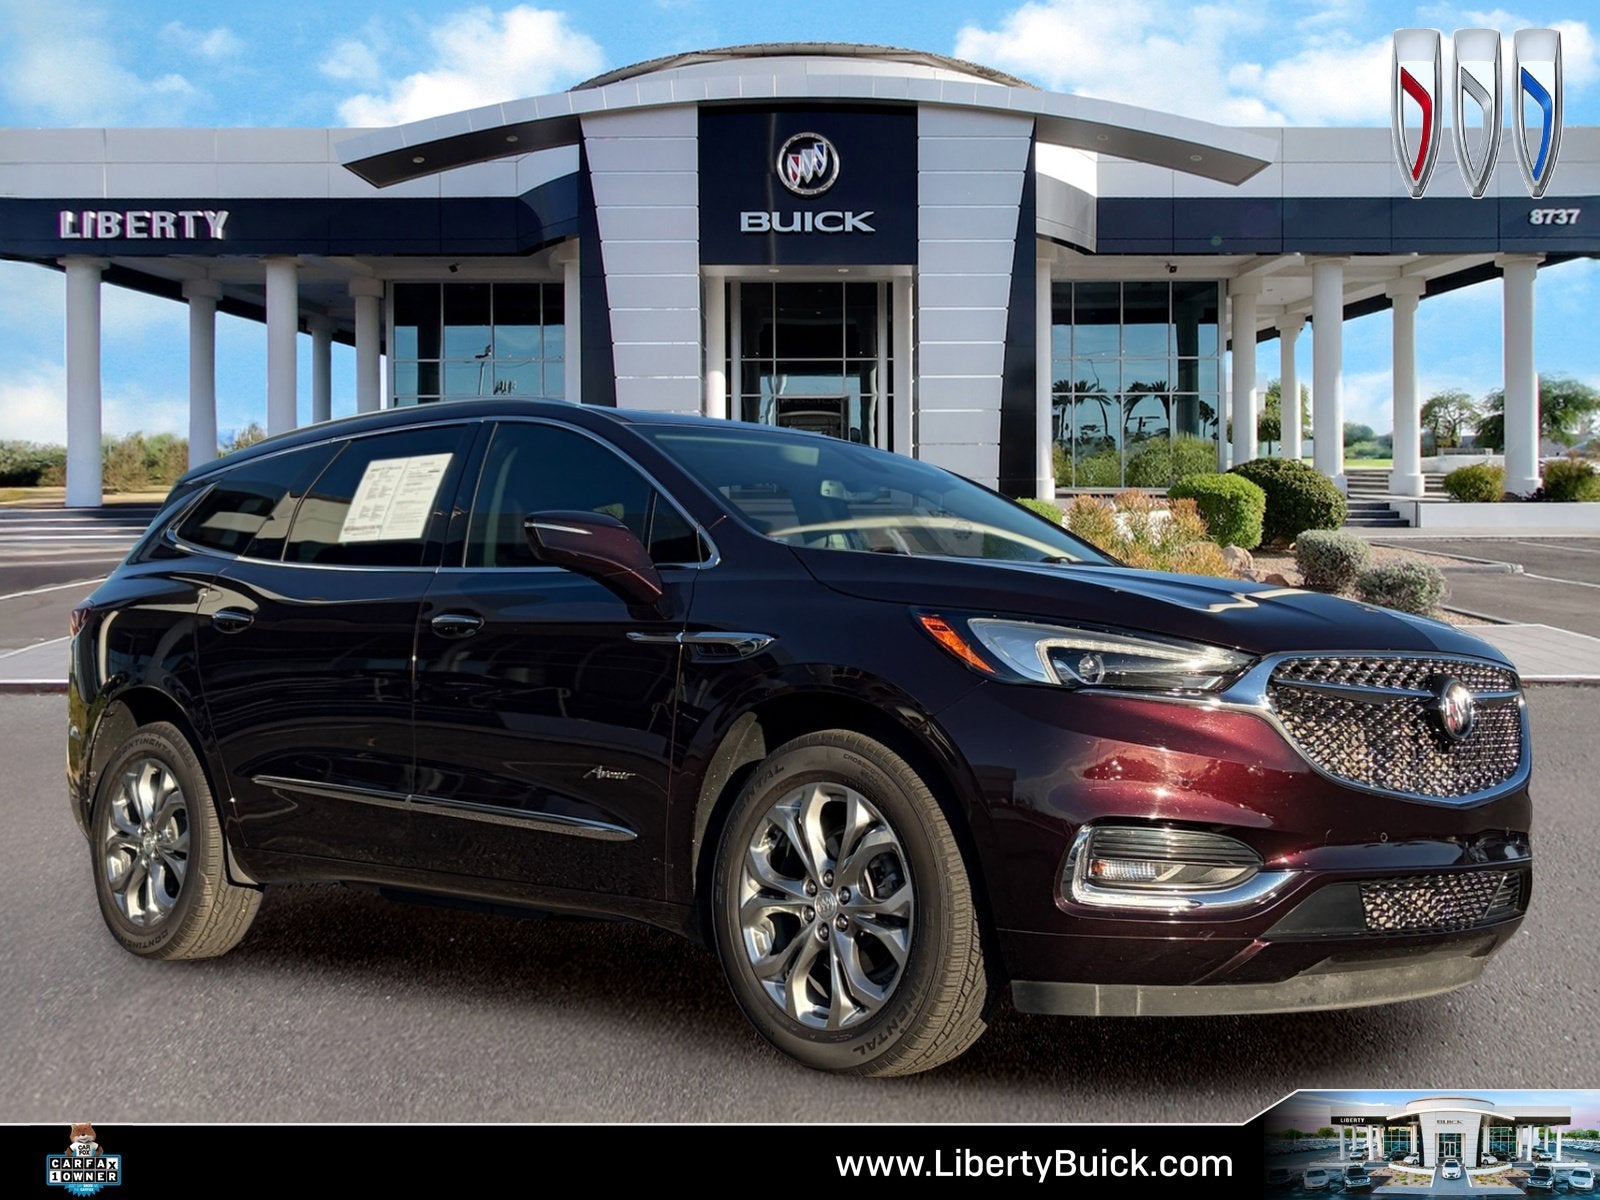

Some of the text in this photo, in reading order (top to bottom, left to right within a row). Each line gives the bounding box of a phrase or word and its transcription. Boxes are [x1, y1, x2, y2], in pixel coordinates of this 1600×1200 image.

[59, 210, 230, 240] LIBERTY
[740, 211, 876, 232] BUICK
[1529, 208, 1581, 225] 8737
